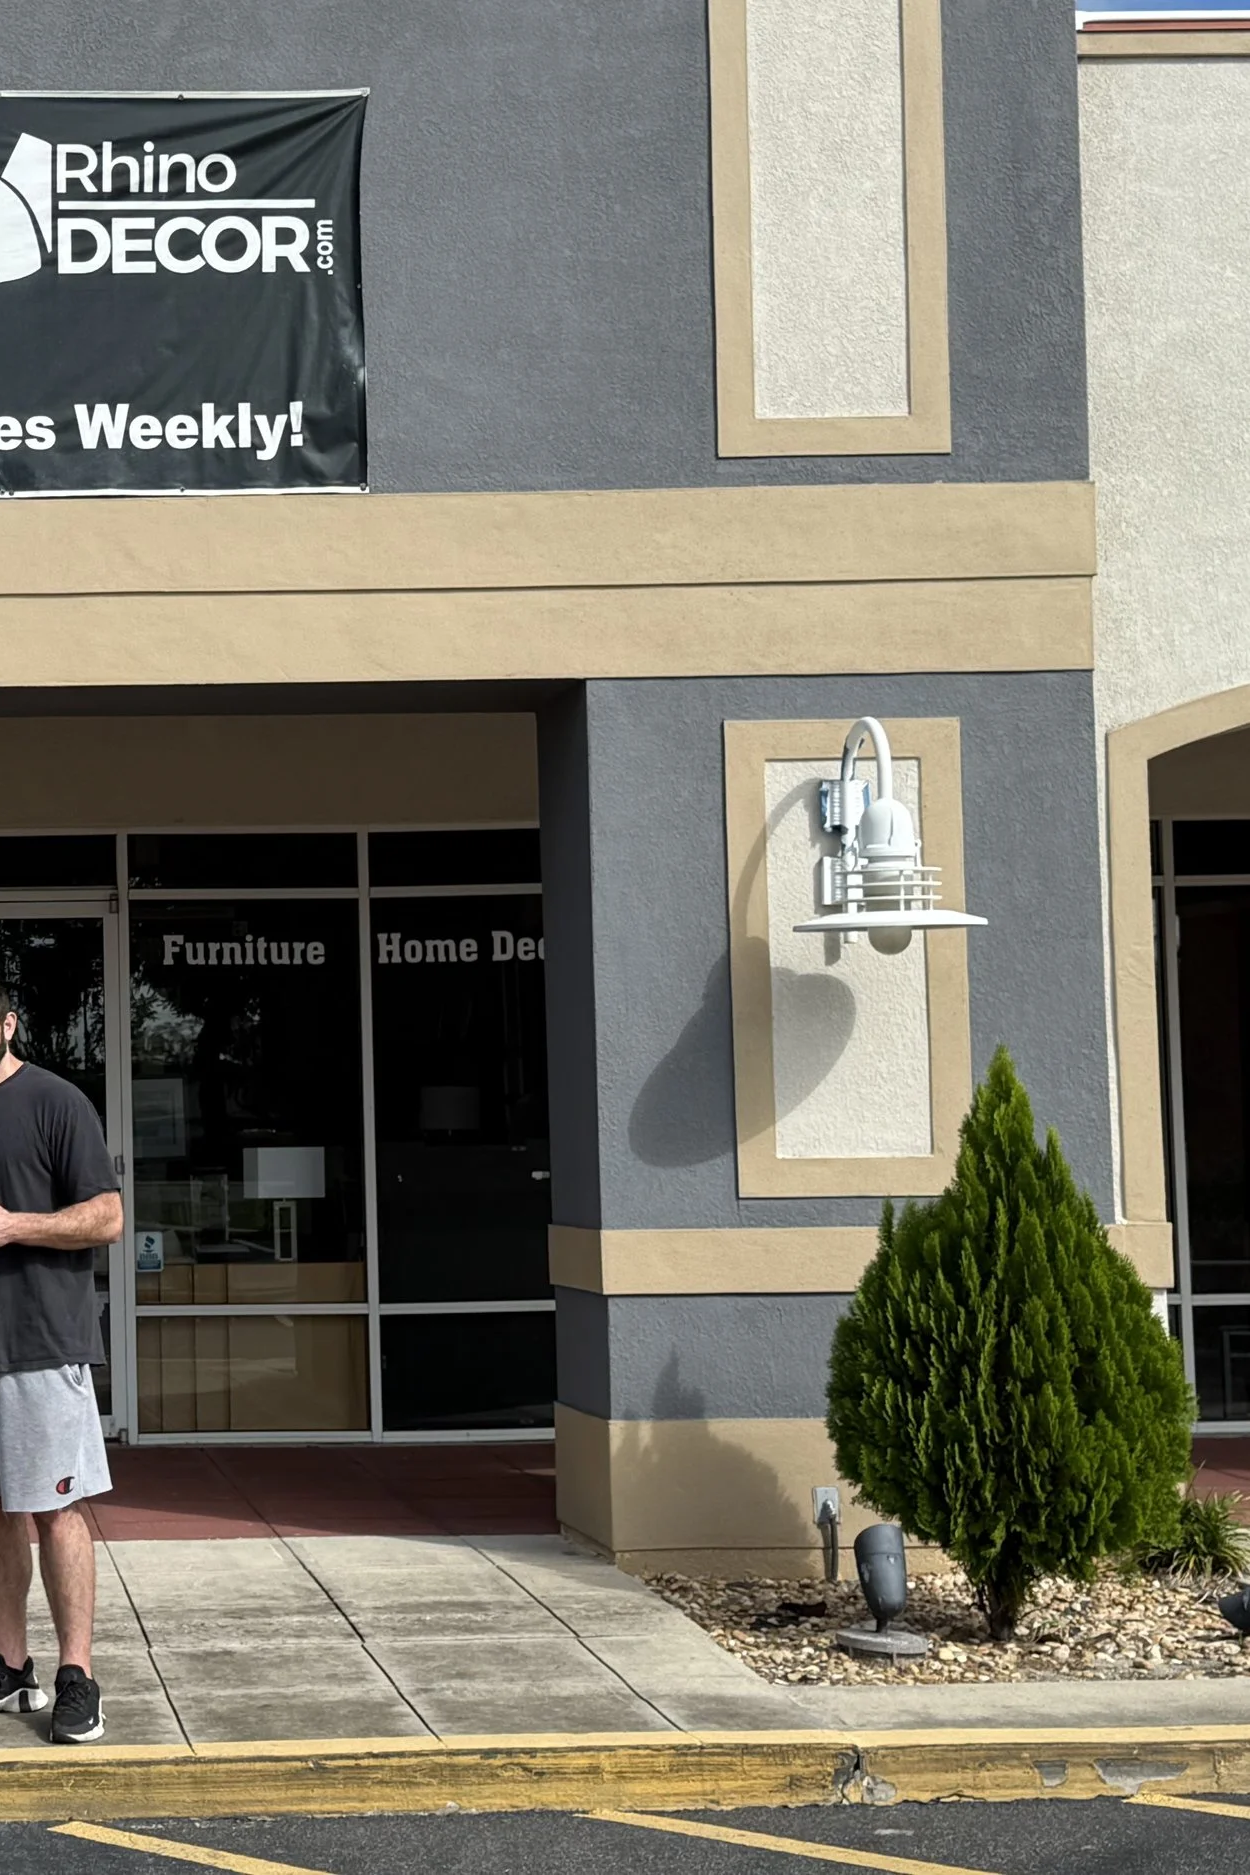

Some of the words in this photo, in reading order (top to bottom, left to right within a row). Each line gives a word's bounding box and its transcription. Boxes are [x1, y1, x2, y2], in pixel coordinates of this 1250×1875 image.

[56, 140, 237, 194] Rhino
[57, 215, 311, 275] DECOR
[316, 219, 334, 276] .com
[74, 400, 304, 461] Weekly!
[162, 934, 326, 966] Furniture
[376, 932, 479, 964] Home
